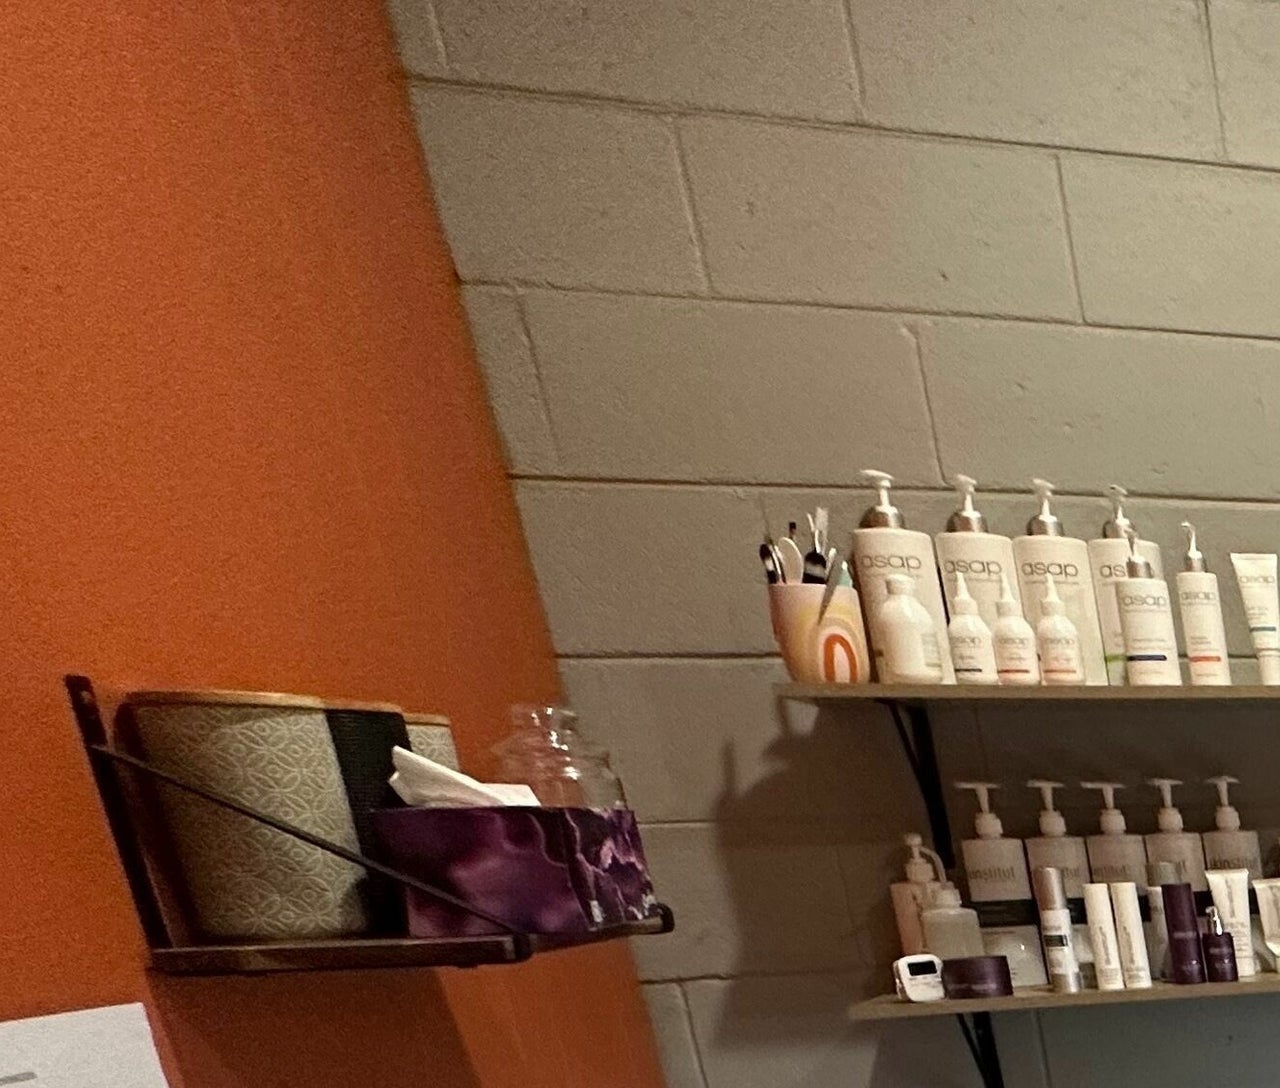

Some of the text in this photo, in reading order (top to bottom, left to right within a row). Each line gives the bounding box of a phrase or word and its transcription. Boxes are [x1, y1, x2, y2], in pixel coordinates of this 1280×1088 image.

[861, 555, 921, 572] asap
[943, 558, 1002, 576] asap
[1021, 560, 1079, 578] asap
[1123, 594, 1167, 607] asap
[1181, 591, 1217, 601] asap
